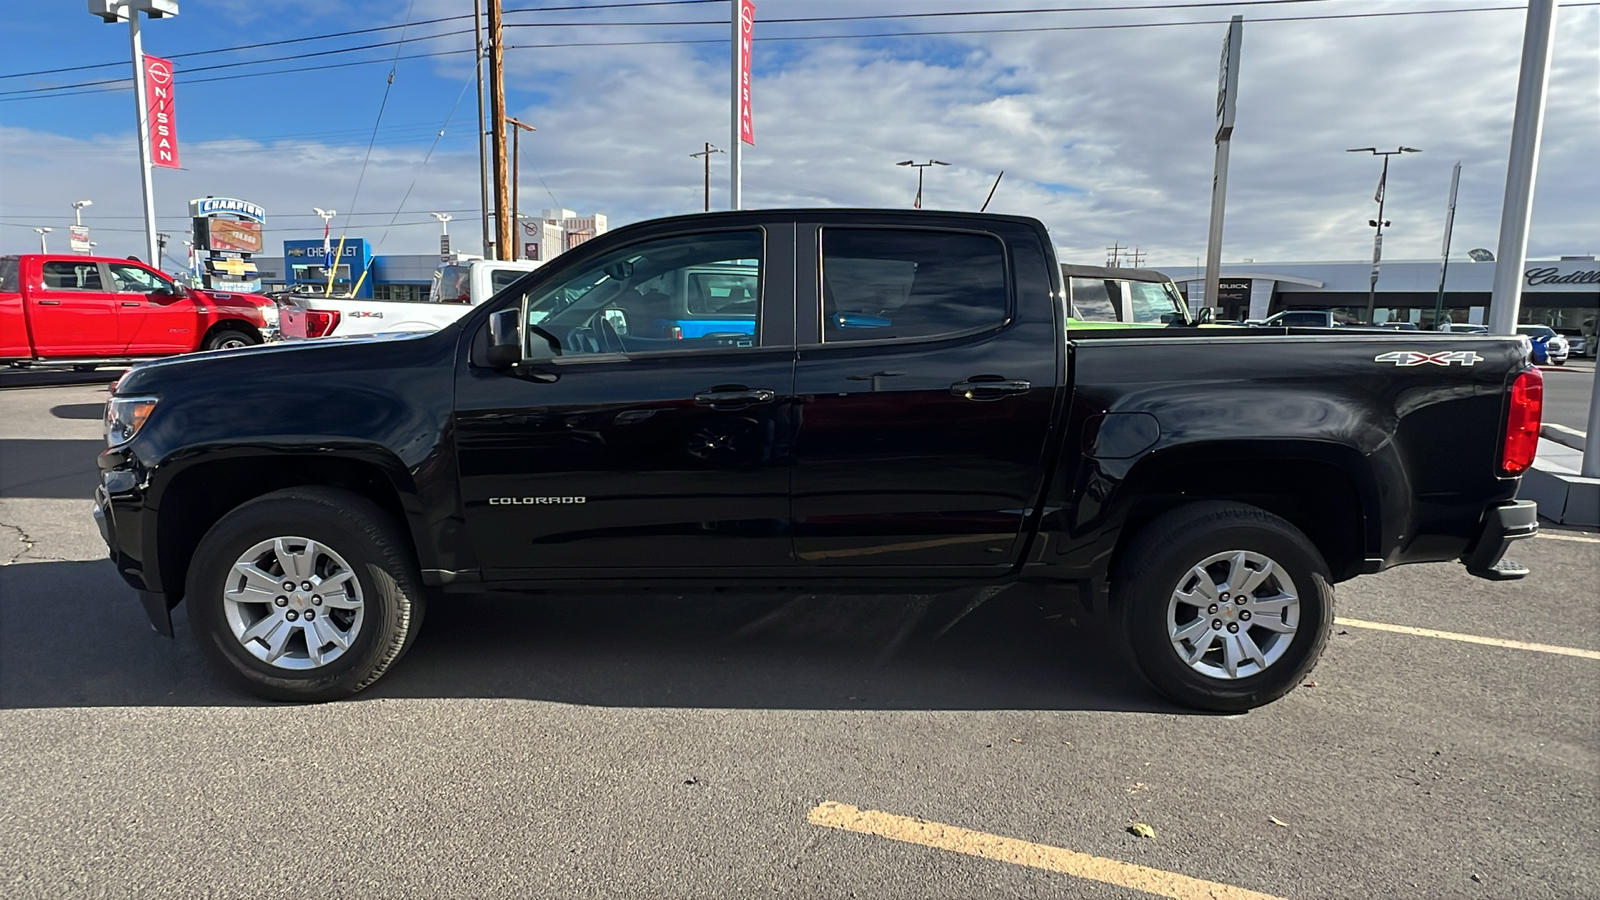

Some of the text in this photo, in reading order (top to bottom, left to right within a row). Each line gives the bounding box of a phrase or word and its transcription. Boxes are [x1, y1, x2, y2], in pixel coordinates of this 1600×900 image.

[155, 86, 172, 161] NISSAN
[203, 200, 262, 217] CHAMPION
[307, 246, 357, 257] CHEROLET
[1525, 267, 1600, 286] Cadill
[489, 496, 586, 504] COLORADO
